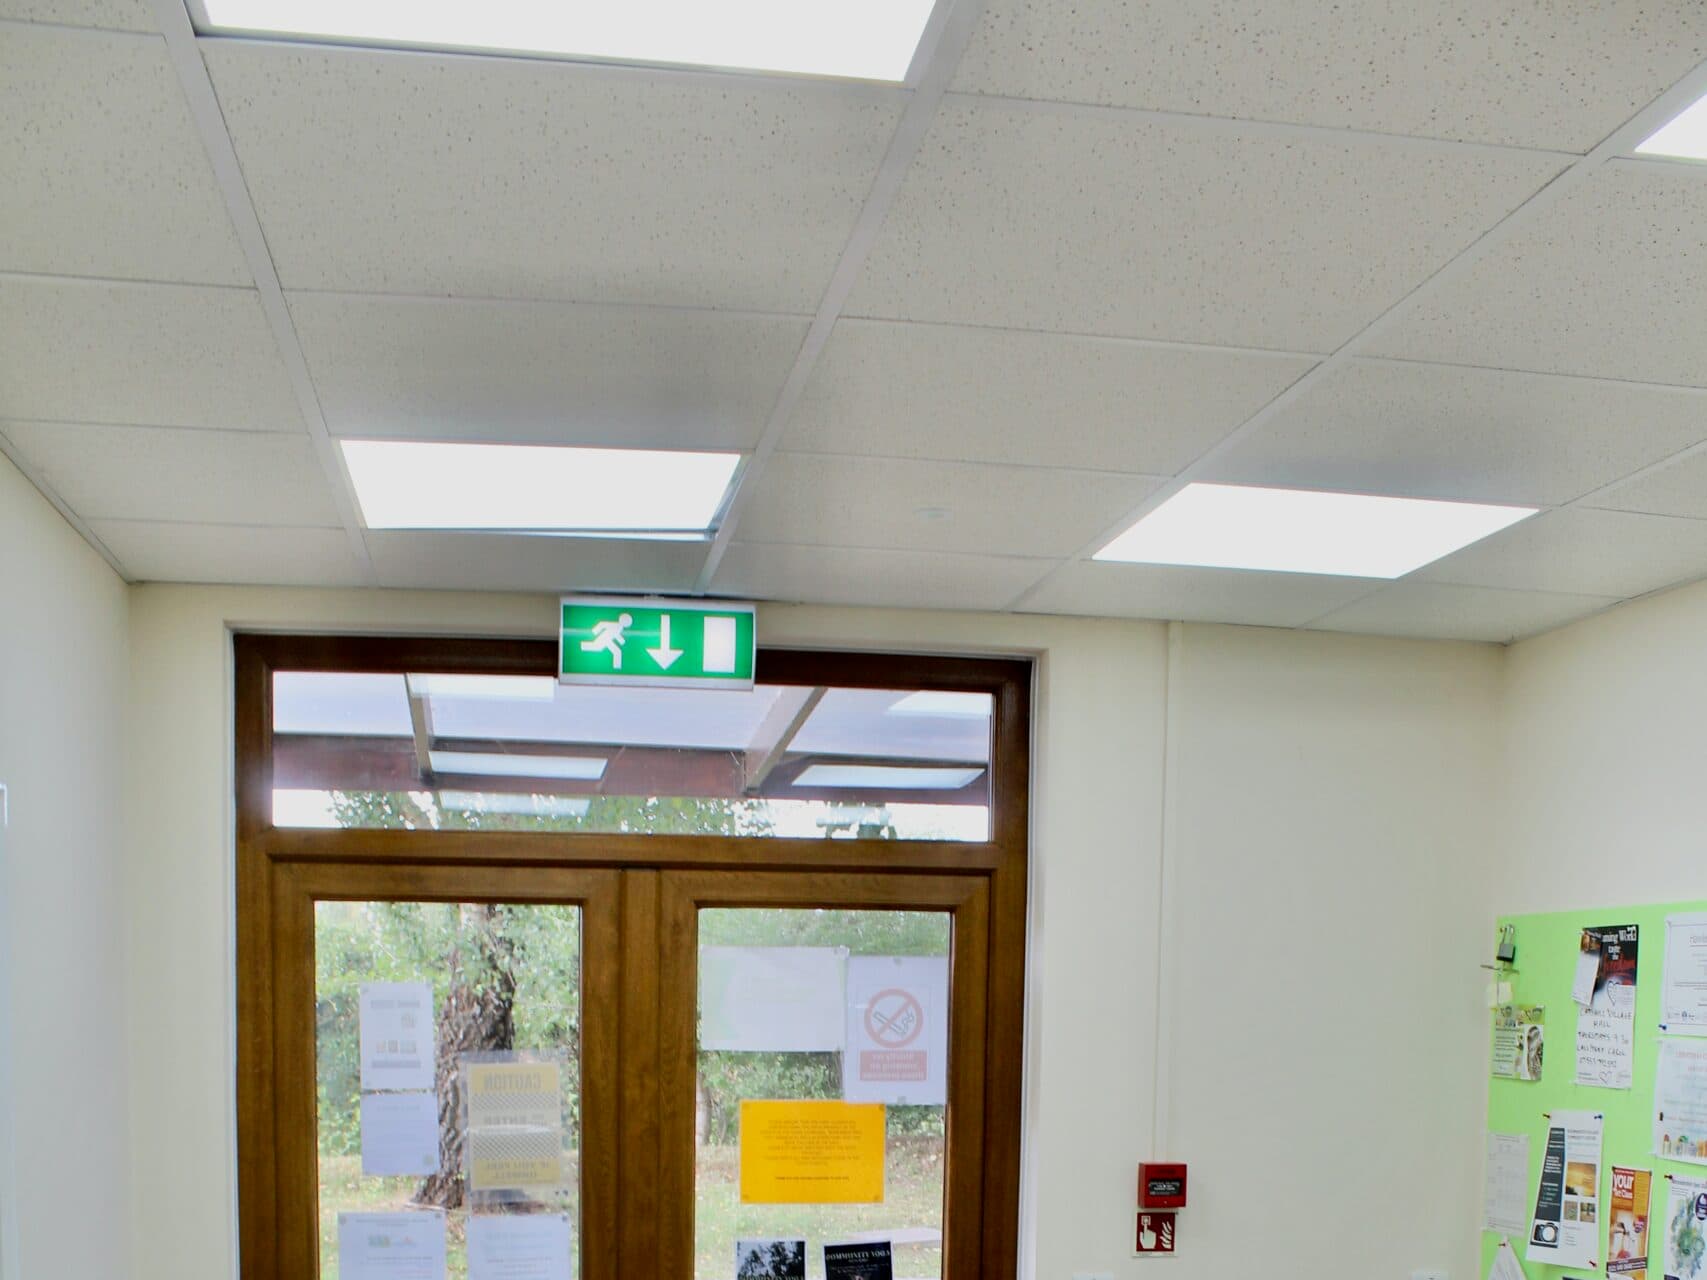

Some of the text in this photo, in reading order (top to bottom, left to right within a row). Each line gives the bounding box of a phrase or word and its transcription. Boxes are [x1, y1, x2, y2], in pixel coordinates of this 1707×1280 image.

[1613, 1173, 1634, 1191] your
[826, 1252, 868, 1261] COMMUNITY
[870, 1250, 891, 1258] YOGA
